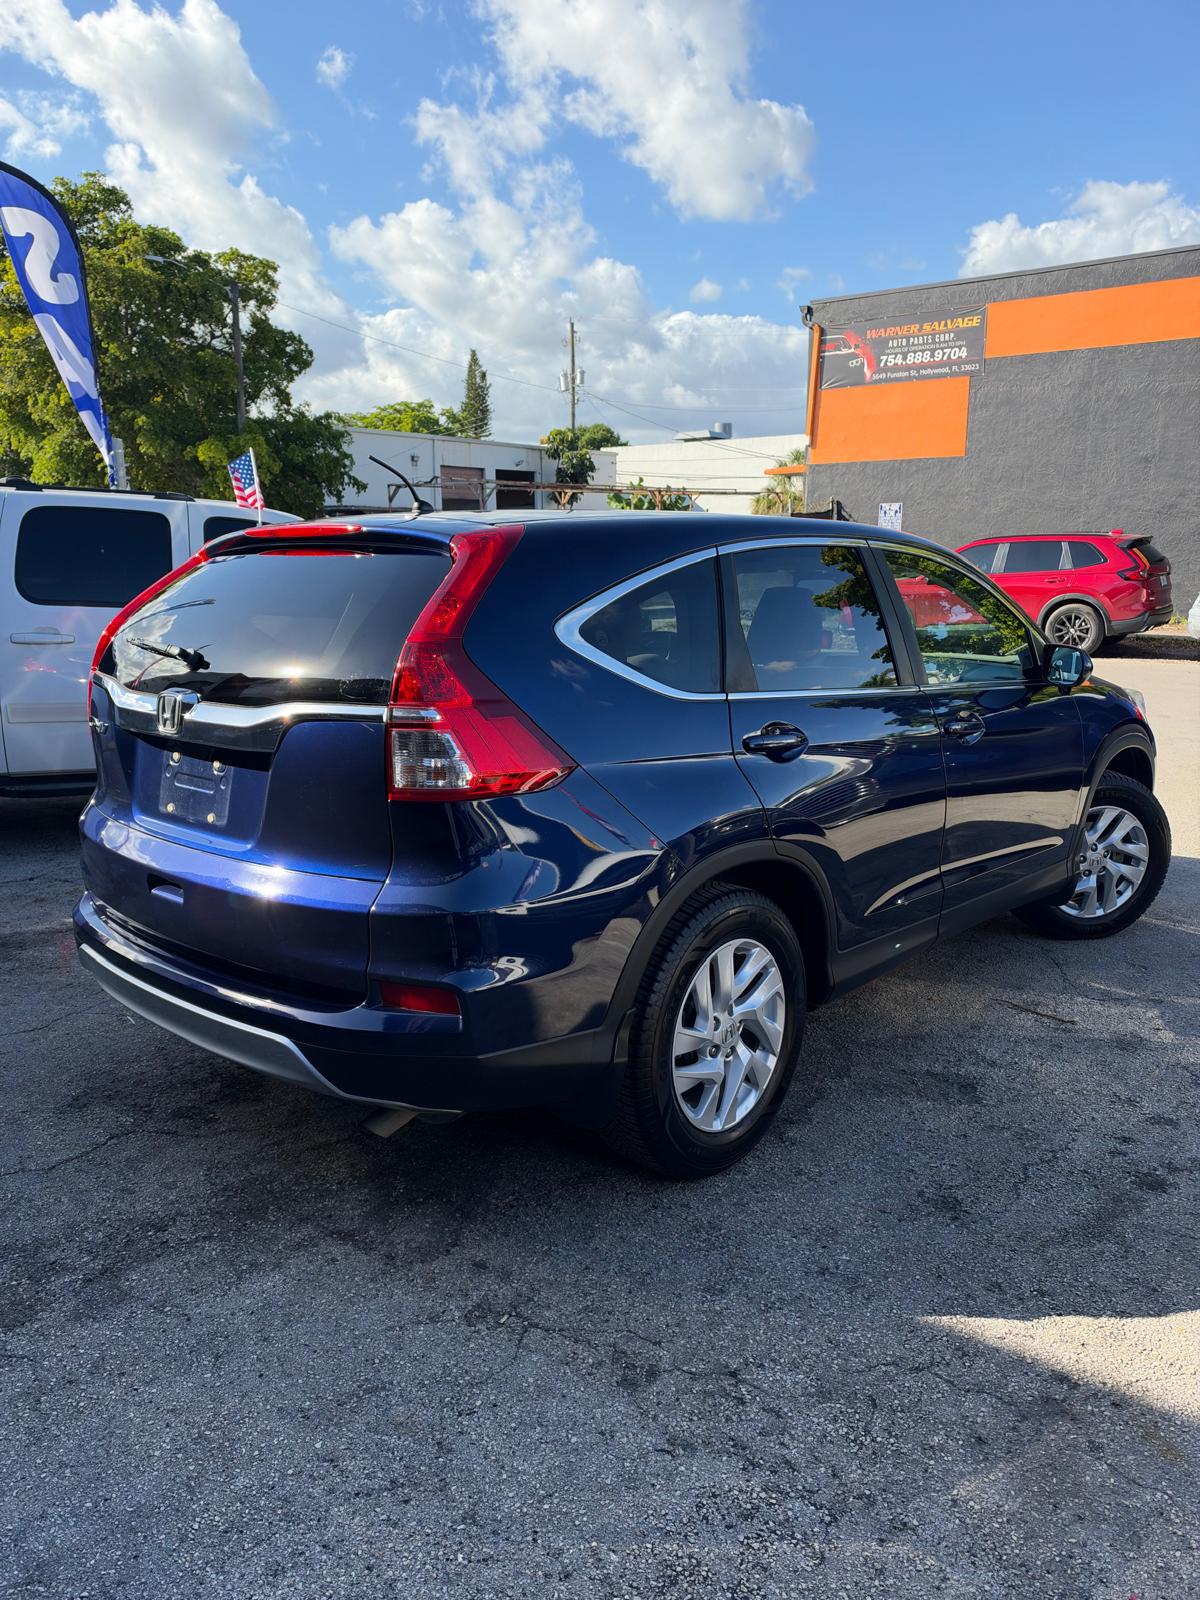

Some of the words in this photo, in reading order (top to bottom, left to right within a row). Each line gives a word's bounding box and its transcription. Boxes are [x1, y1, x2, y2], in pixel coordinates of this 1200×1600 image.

[866, 324, 920, 339] WARNER
[922, 315, 982, 332] SALVAGE
[889, 338, 907, 347] AUTO
[910, 335, 931, 345] PARTS
[935, 333, 956, 342] CORP.
[909, 344, 936, 352] OPERATION
[880, 347, 968, 367] 754.888.9704
[872, 372, 886, 381] 5649
[887, 369, 910, 379] Funston
[919, 366, 951, 375] Hollywood,
[960, 363, 980, 371] 33023
